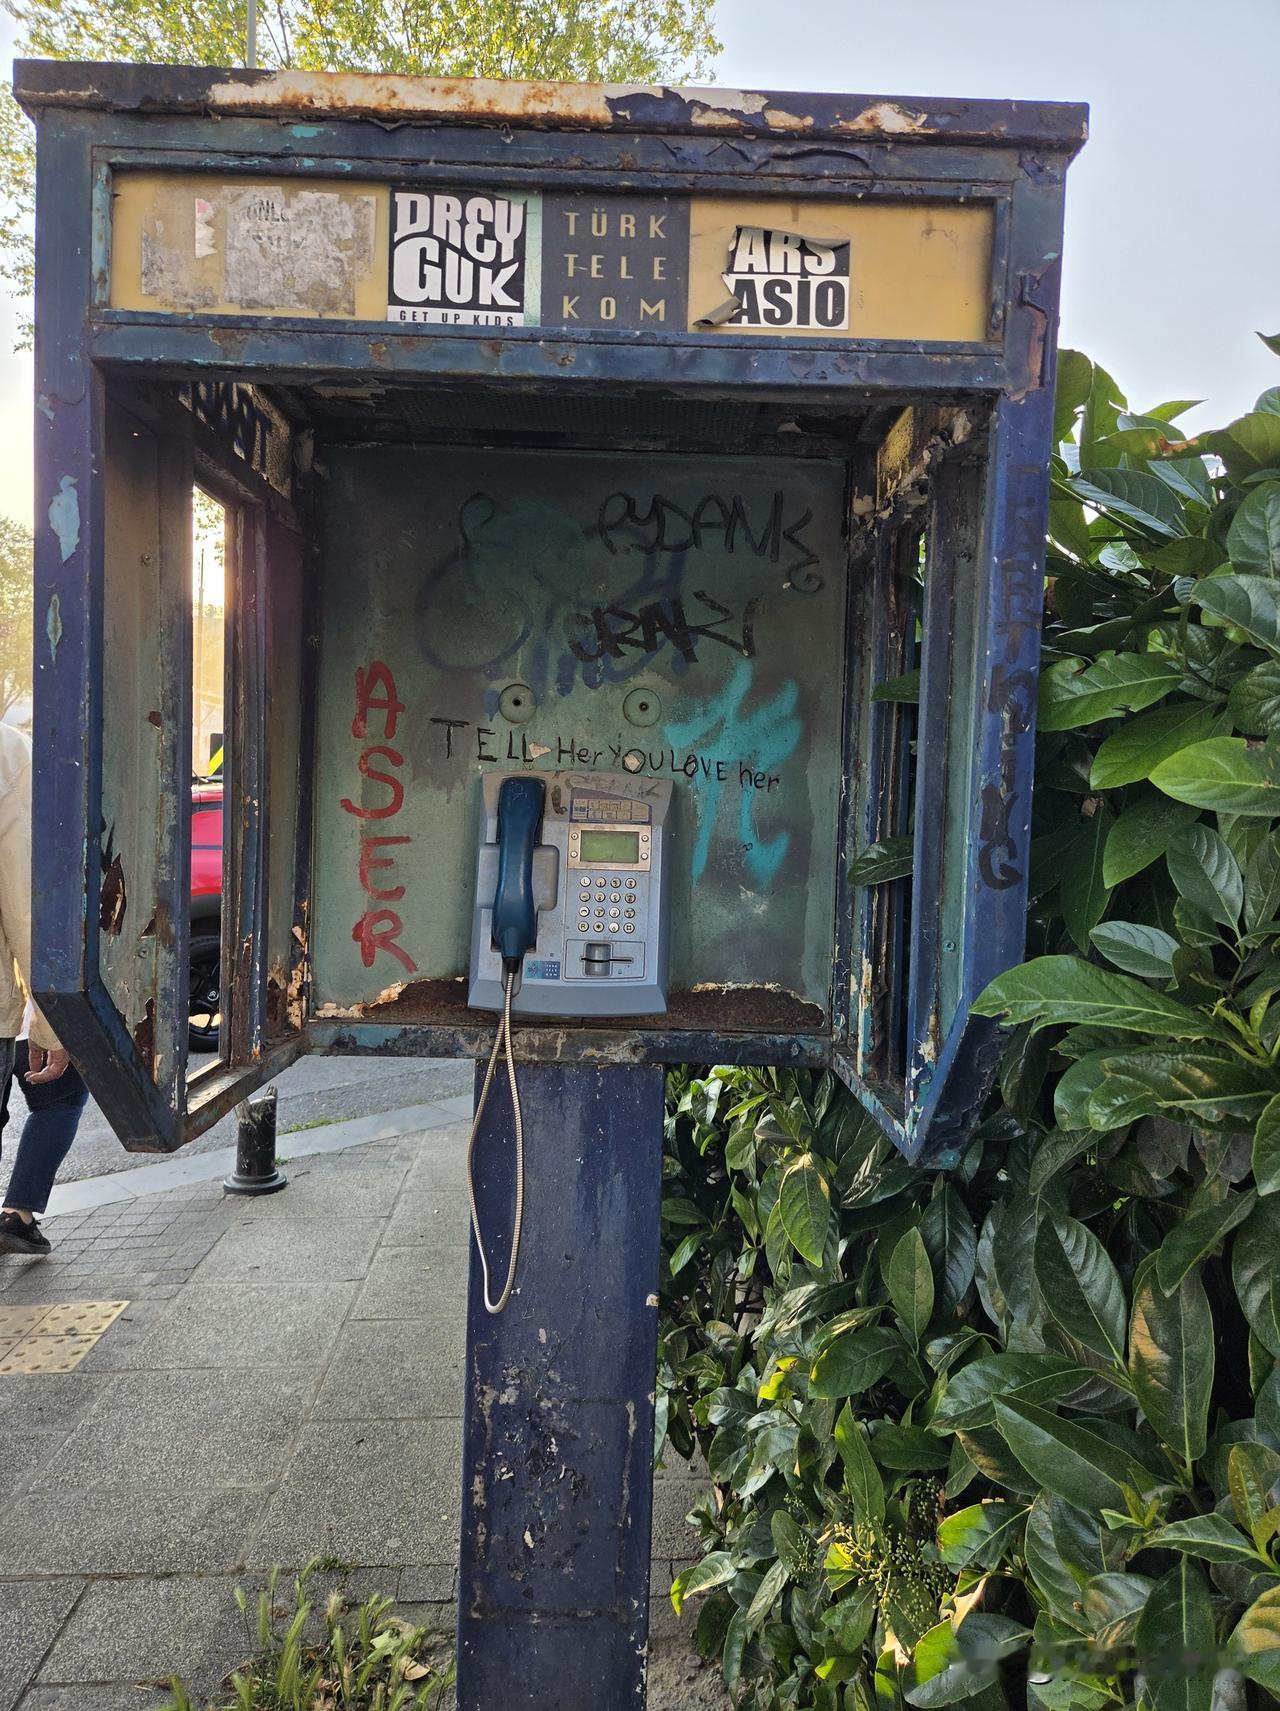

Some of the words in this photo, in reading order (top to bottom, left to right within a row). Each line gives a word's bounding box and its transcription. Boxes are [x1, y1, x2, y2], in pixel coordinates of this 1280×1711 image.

[394, 192, 523, 263] DREY
[563, 208, 667, 239] TÜRK
[393, 237, 521, 307] GUK
[563, 253, 667, 280] TELE
[728, 227, 836, 275] ARS
[400, 310, 429, 322] GET
[441, 313, 461, 324] UP
[473, 314, 514, 327] KIDS
[563, 295, 666, 321] KOM
[429, 717, 535, 763] TELL
[557, 736, 602, 766] Her
[739, 761, 781, 793] her
[340, 660, 418, 974] ASER
